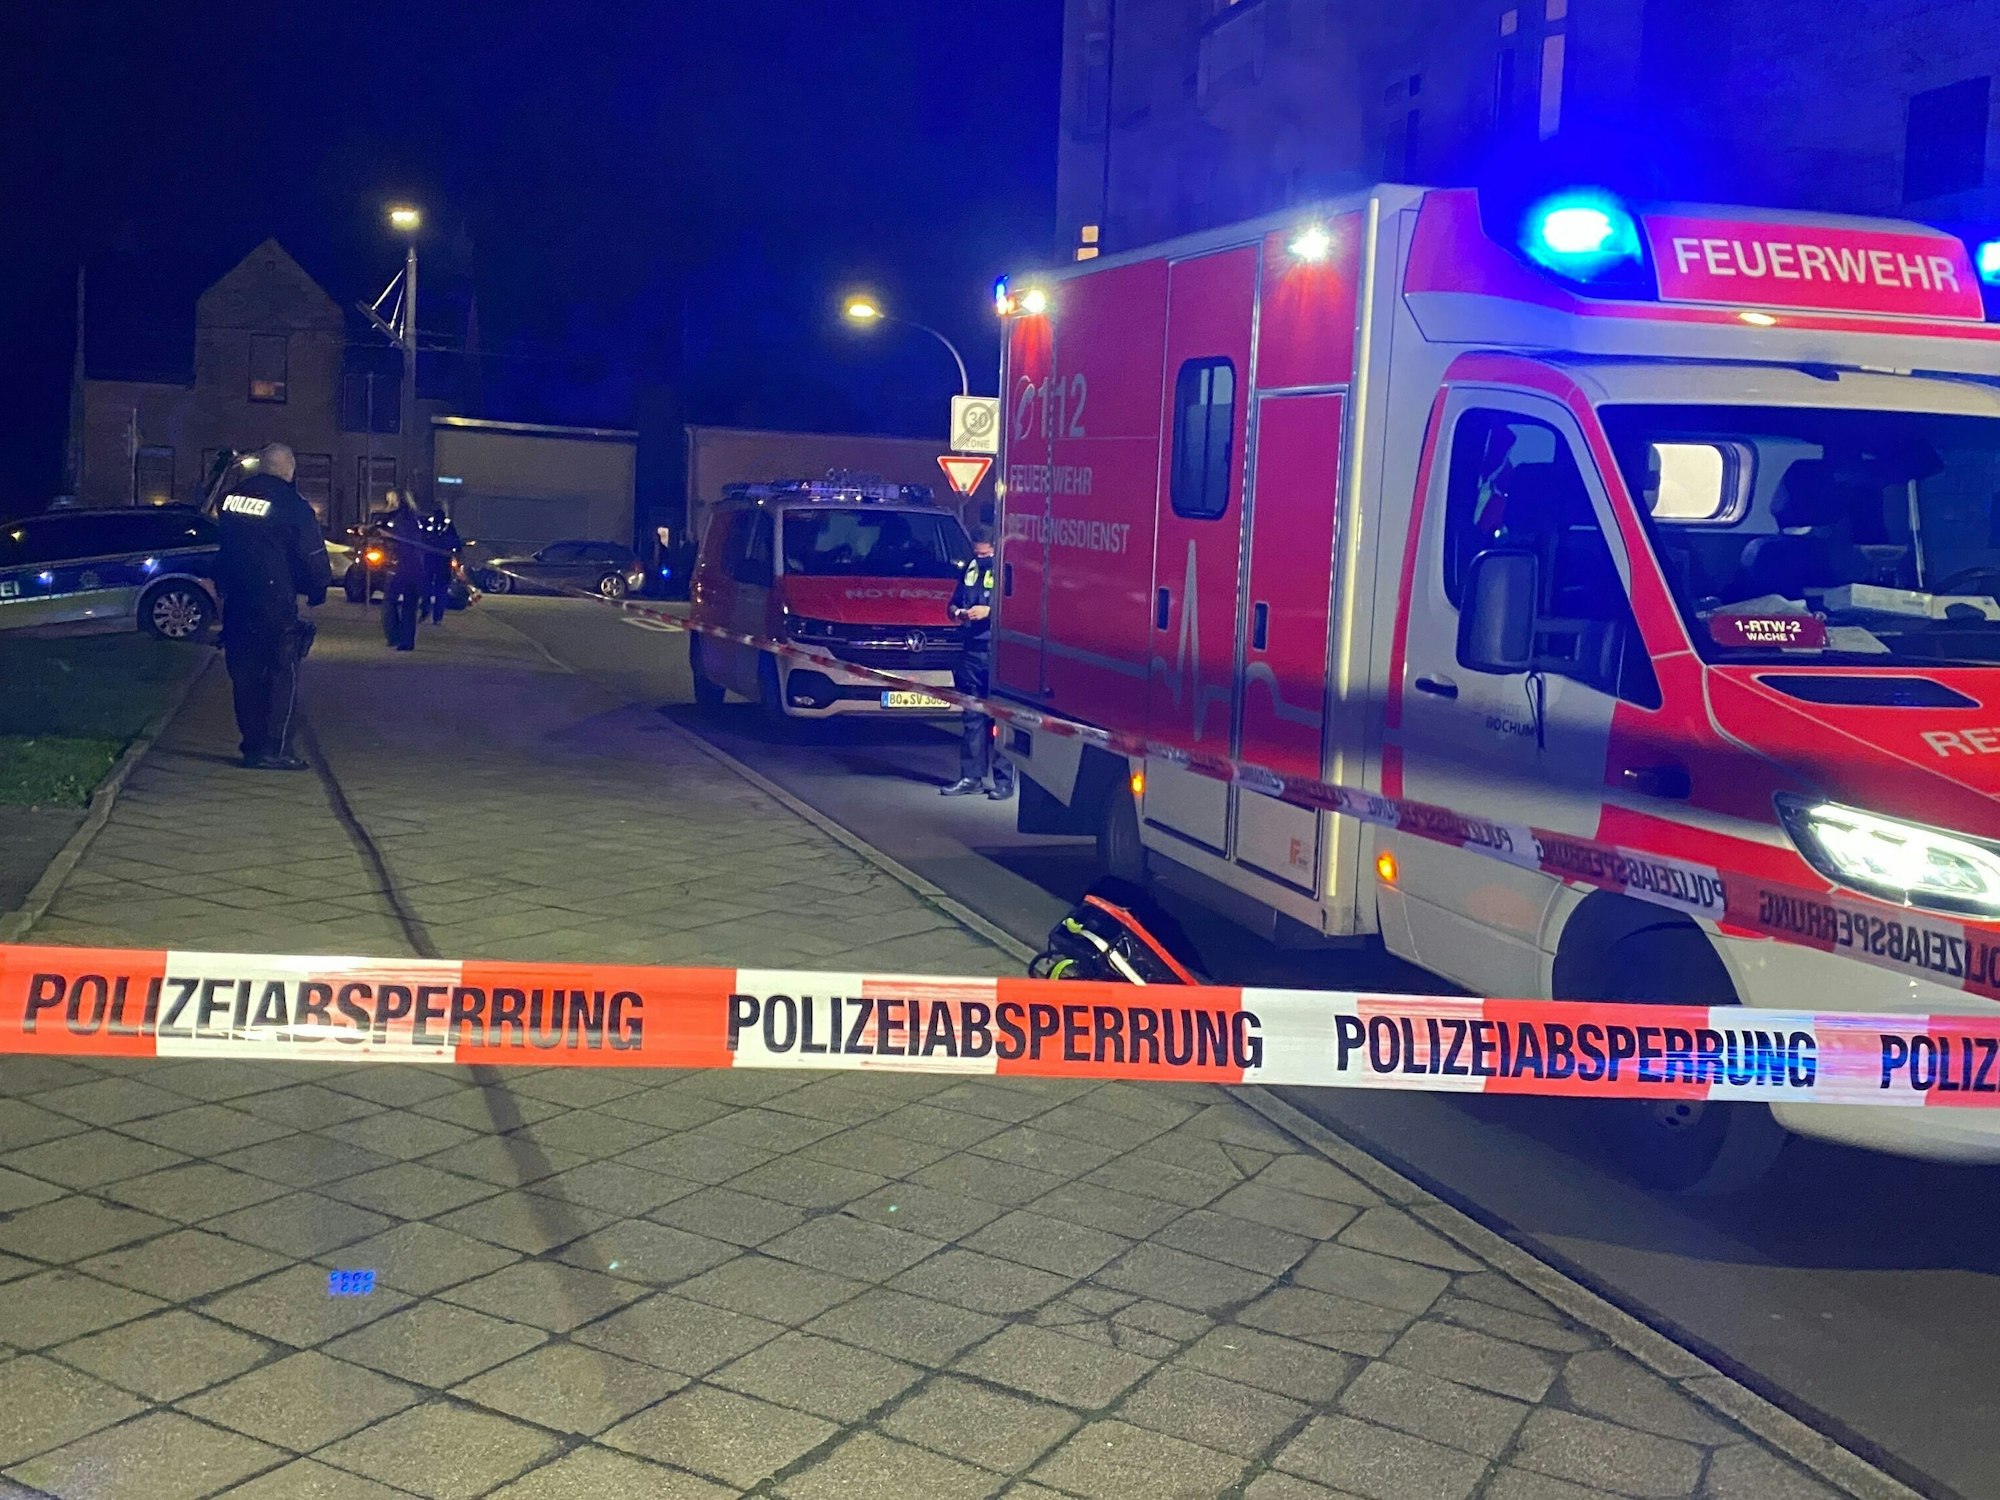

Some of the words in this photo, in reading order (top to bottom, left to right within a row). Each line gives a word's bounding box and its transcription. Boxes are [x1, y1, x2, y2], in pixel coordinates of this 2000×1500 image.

[1672, 237, 1960, 293] FEUERWEHR
[1038, 373, 1087, 438] 112
[968, 411, 988, 429] 30
[1009, 464, 1093, 496] FEUERWEHR
[222, 494, 271, 516] POLIZEI
[1735, 620, 1802, 633] 1-RTW-2
[1746, 632, 1788, 642] WACHE
[1485, 715, 1535, 738] BOCHUM
[1920, 727, 2000, 757] RE
[22, 972, 645, 1052] POLIZEIABSPERRUNG
[727, 993, 1263, 1069] POLIZEIABSPERRUNG
[1334, 1014, 1816, 1089] POLIZEIABSPERRUNG
[1880, 1034, 2000, 1093] POLIZ
